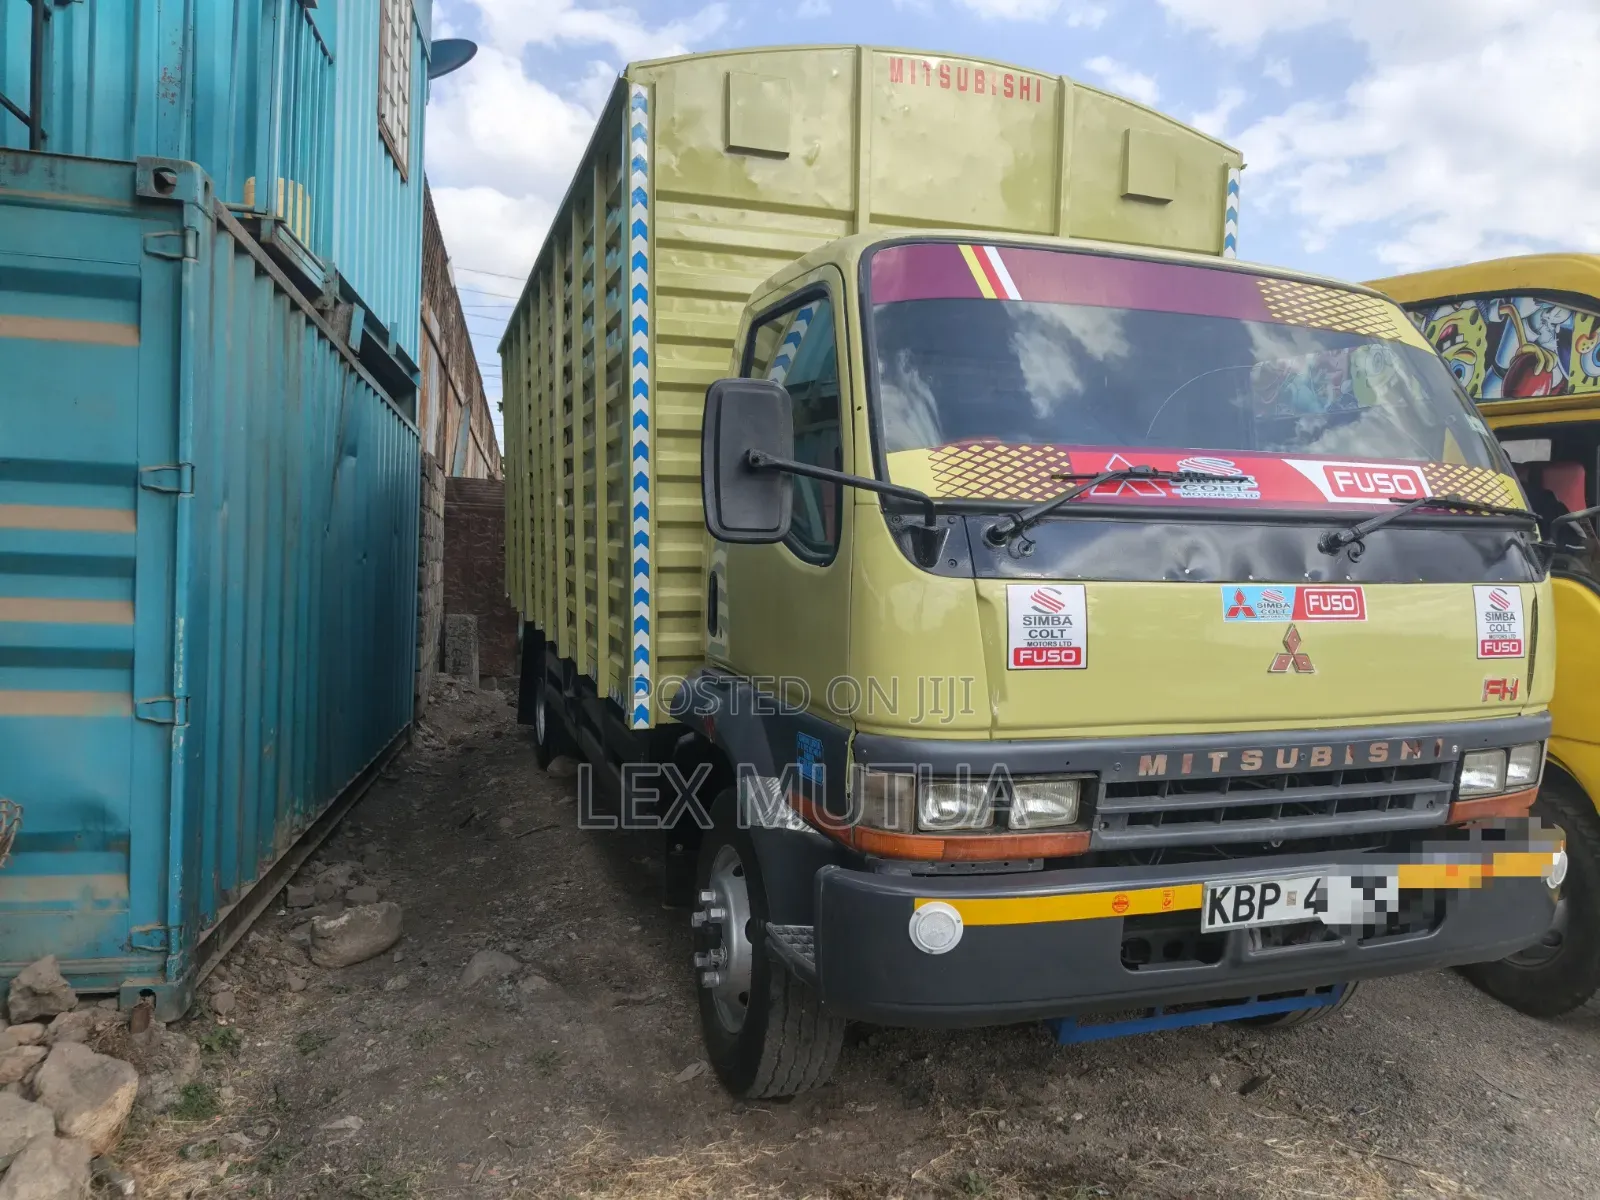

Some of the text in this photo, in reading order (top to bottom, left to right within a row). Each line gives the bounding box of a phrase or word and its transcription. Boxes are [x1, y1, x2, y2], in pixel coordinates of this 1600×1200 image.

[889, 57, 1041, 102] MITSUBISHI
[1333, 471, 1417, 494] FUSO
[1309, 595, 1354, 611] FUSO
[1023, 616, 1073, 625] SIMBA
[1485, 612, 1516, 621] SIMBA
[1028, 629, 1066, 638] COLT
[1490, 624, 1512, 632] COLT
[1484, 642, 1518, 653] FUSO
[1020, 650, 1076, 663] FUSO
[1208, 883, 1281, 925] KBP
